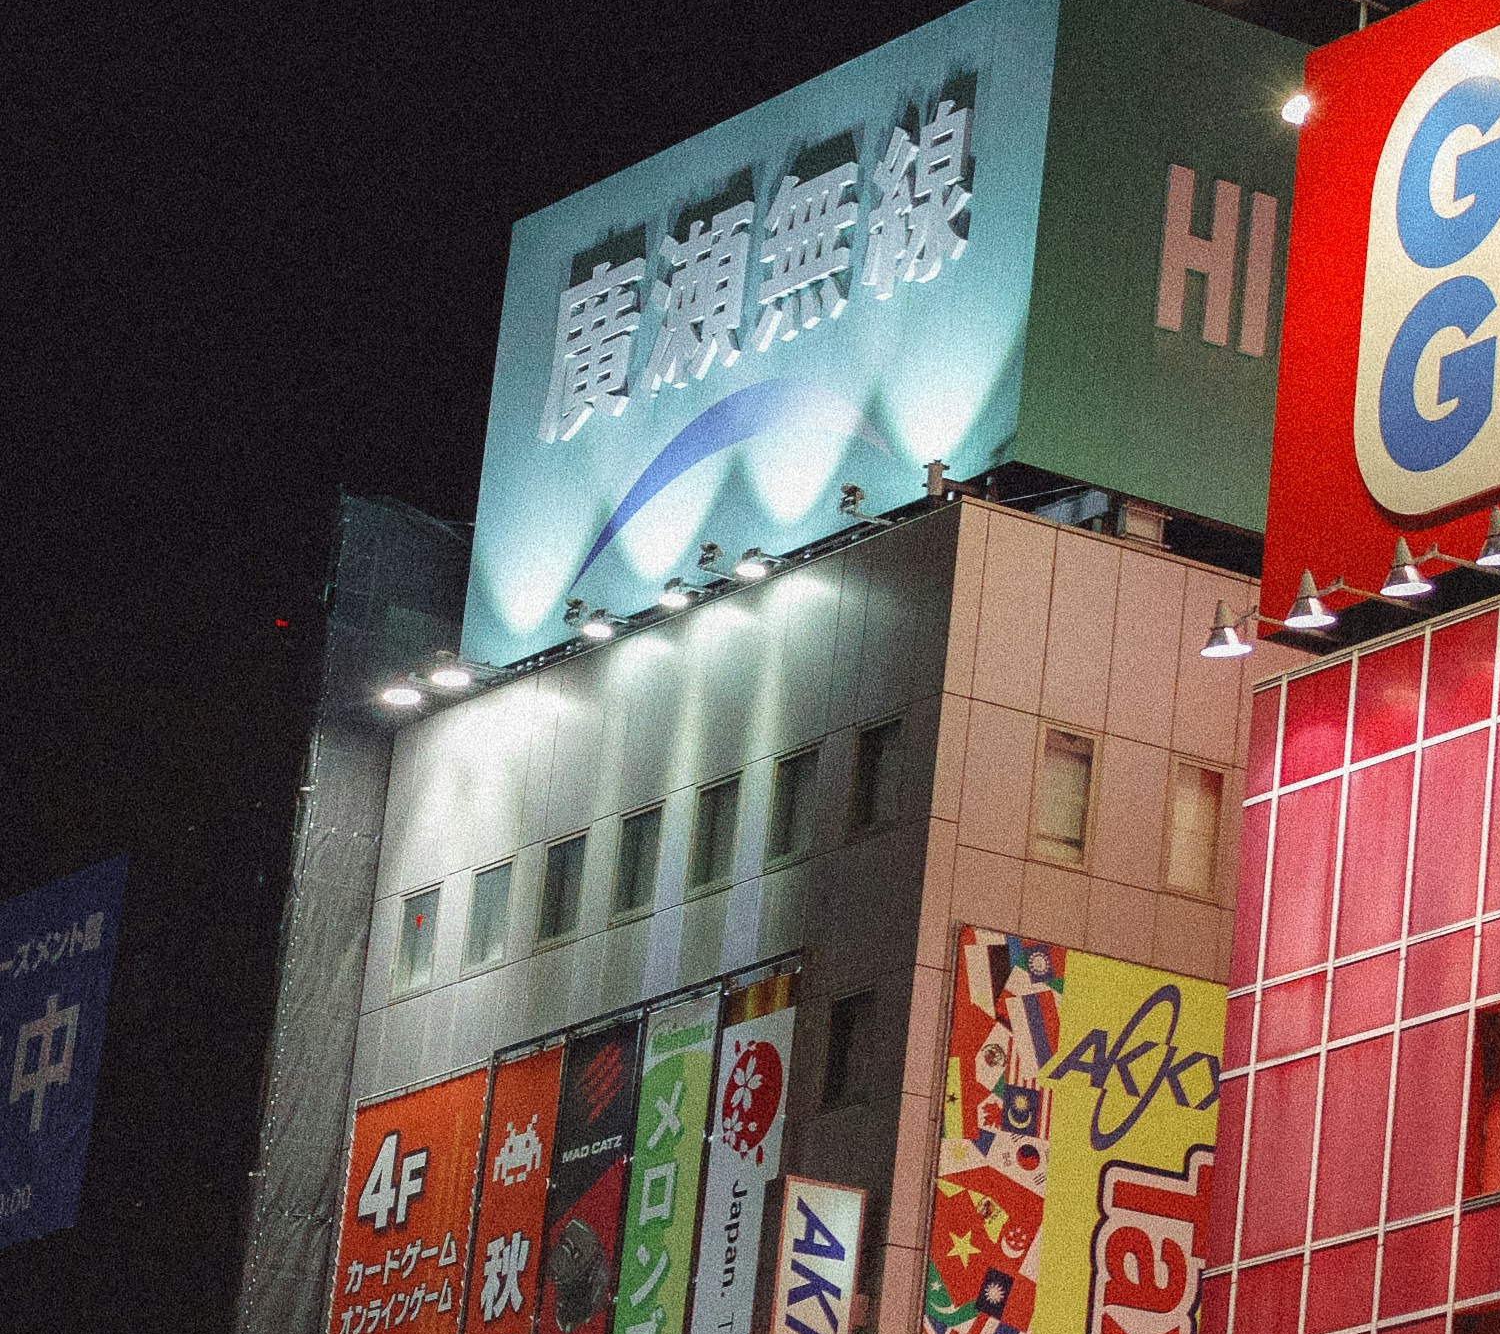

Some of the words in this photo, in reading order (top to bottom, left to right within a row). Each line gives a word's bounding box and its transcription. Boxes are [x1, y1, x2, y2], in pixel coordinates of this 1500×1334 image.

[9, 994, 80, 1132] 中
[358, 1133, 426, 1231] 4F
[562, 1144, 591, 1164] MAD
[592, 1134, 623, 1159] CATZ
[343, 1232, 457, 1297] カードゲーム
